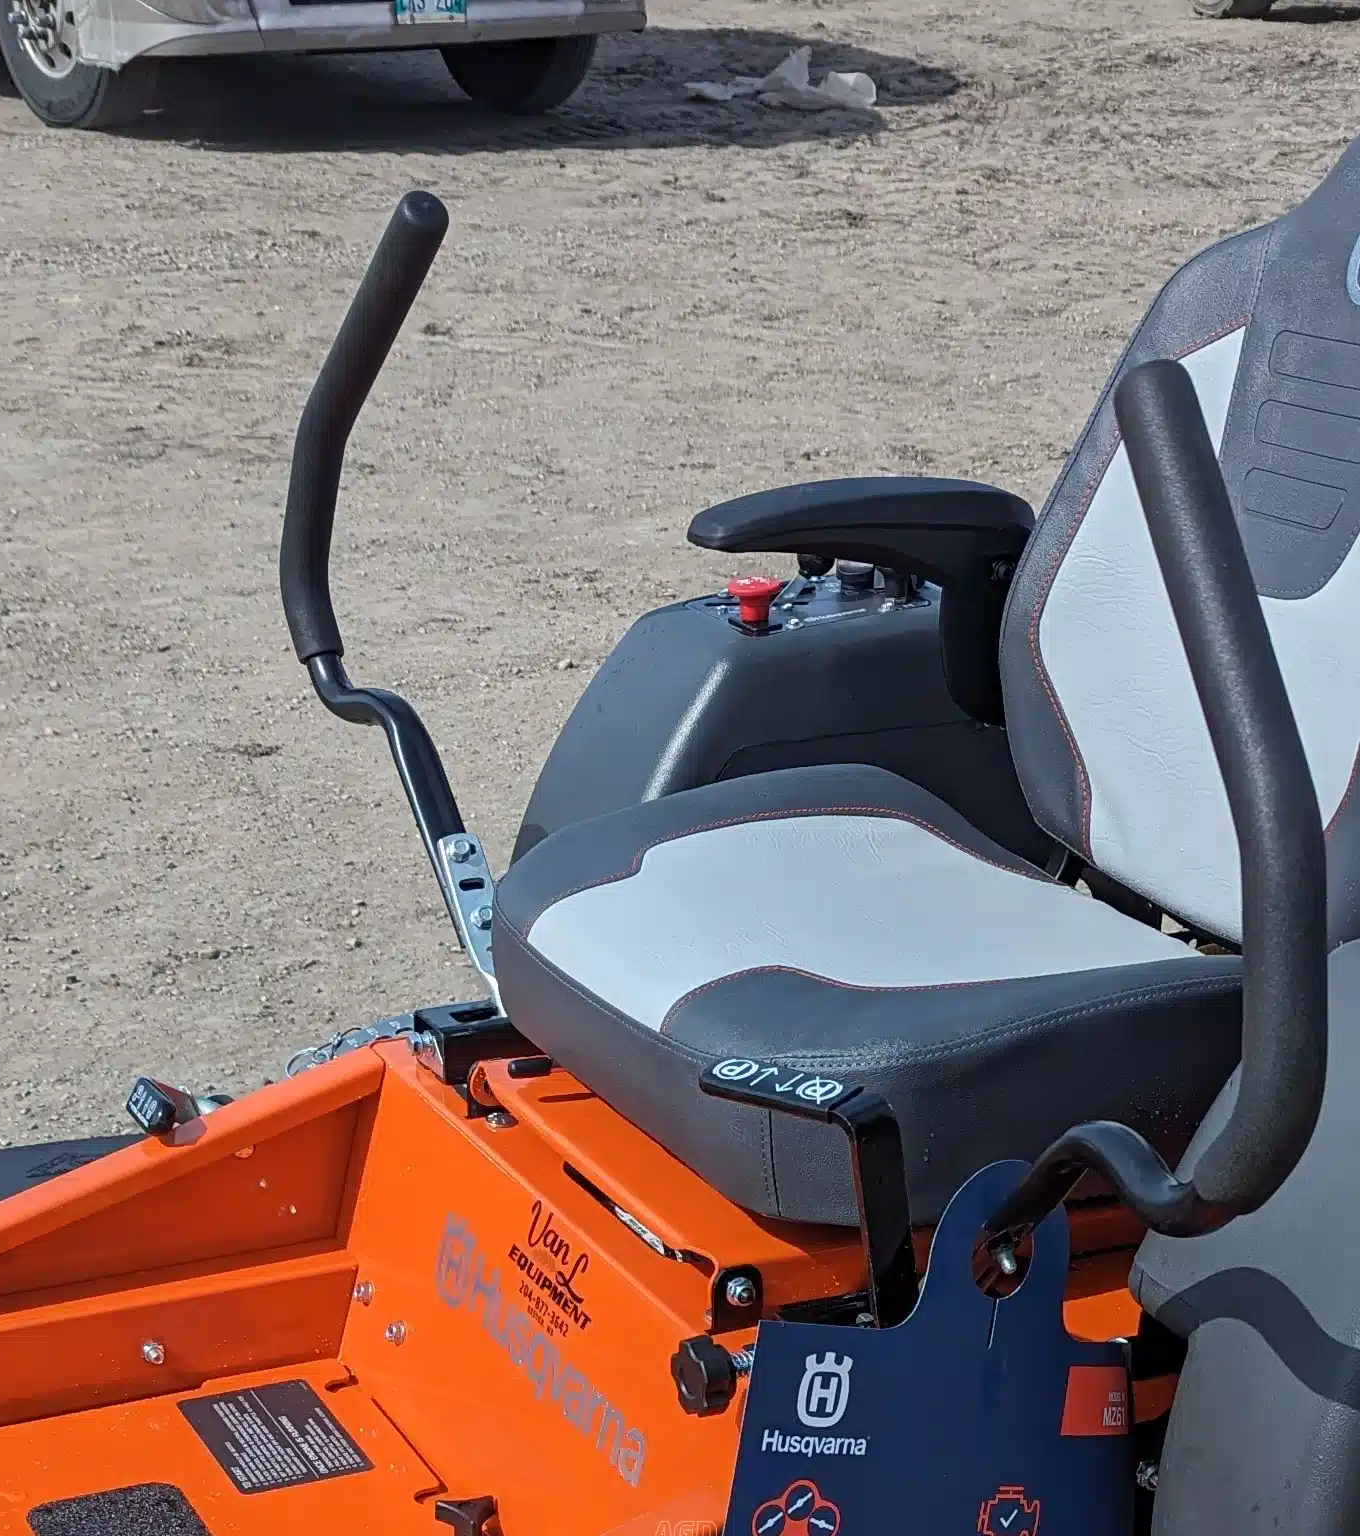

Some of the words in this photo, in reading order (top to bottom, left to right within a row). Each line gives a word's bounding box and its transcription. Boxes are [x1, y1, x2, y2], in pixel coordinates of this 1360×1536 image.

[528, 1200, 570, 1265] Van
[508, 1244, 592, 1330] EQUIPMENT
[472, 1250, 647, 1486] Husqvarna
[762, 1429, 868, 1457] Husqvarna
[1102, 1406, 1125, 1426] MZ61
